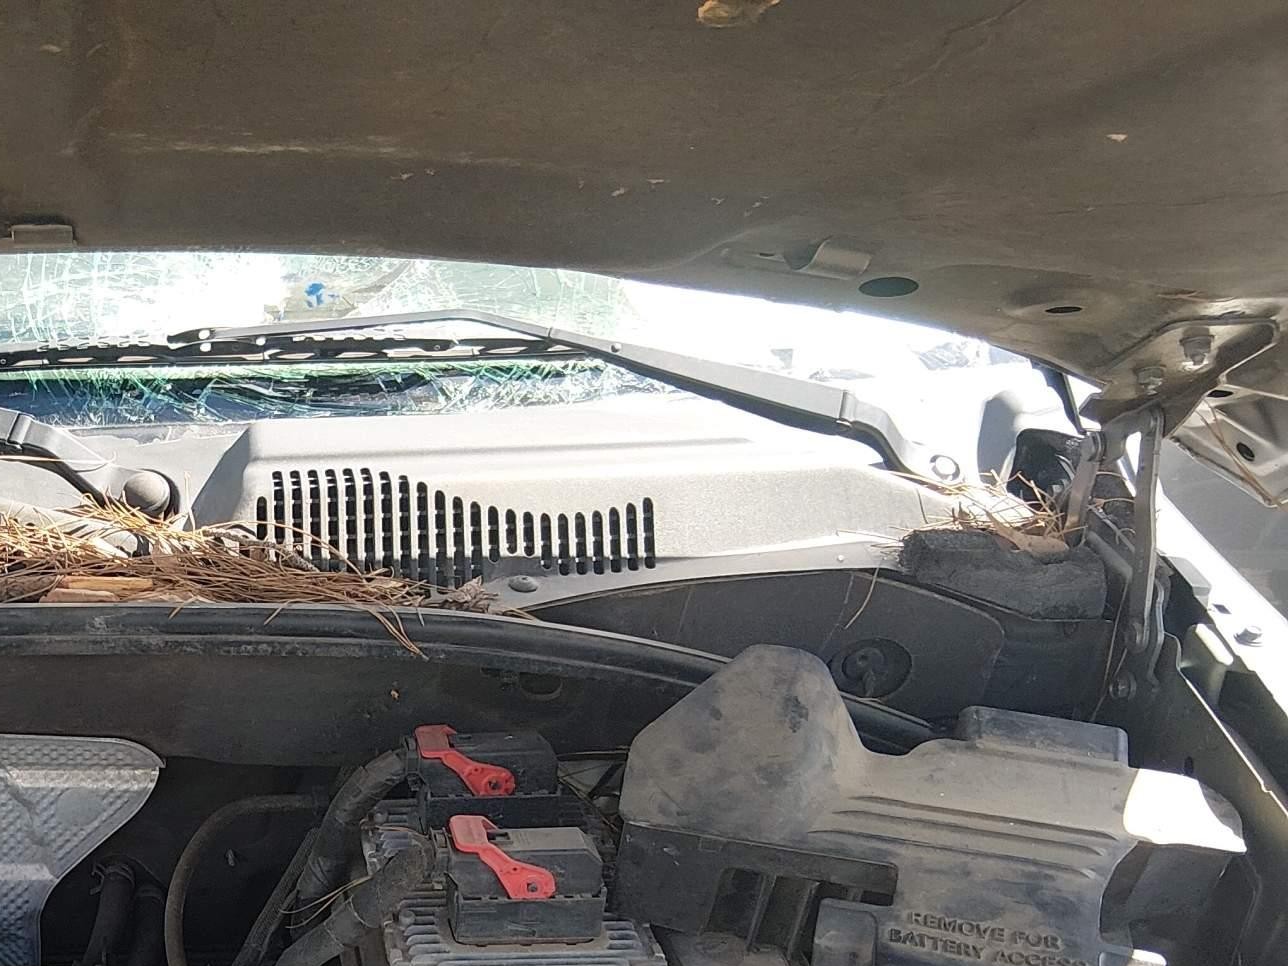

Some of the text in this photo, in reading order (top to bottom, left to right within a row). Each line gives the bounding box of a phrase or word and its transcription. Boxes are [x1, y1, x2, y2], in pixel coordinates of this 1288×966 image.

[889, 929, 987, 959] BATTERY
[909, 911, 1061, 950] REMOVE FOR
